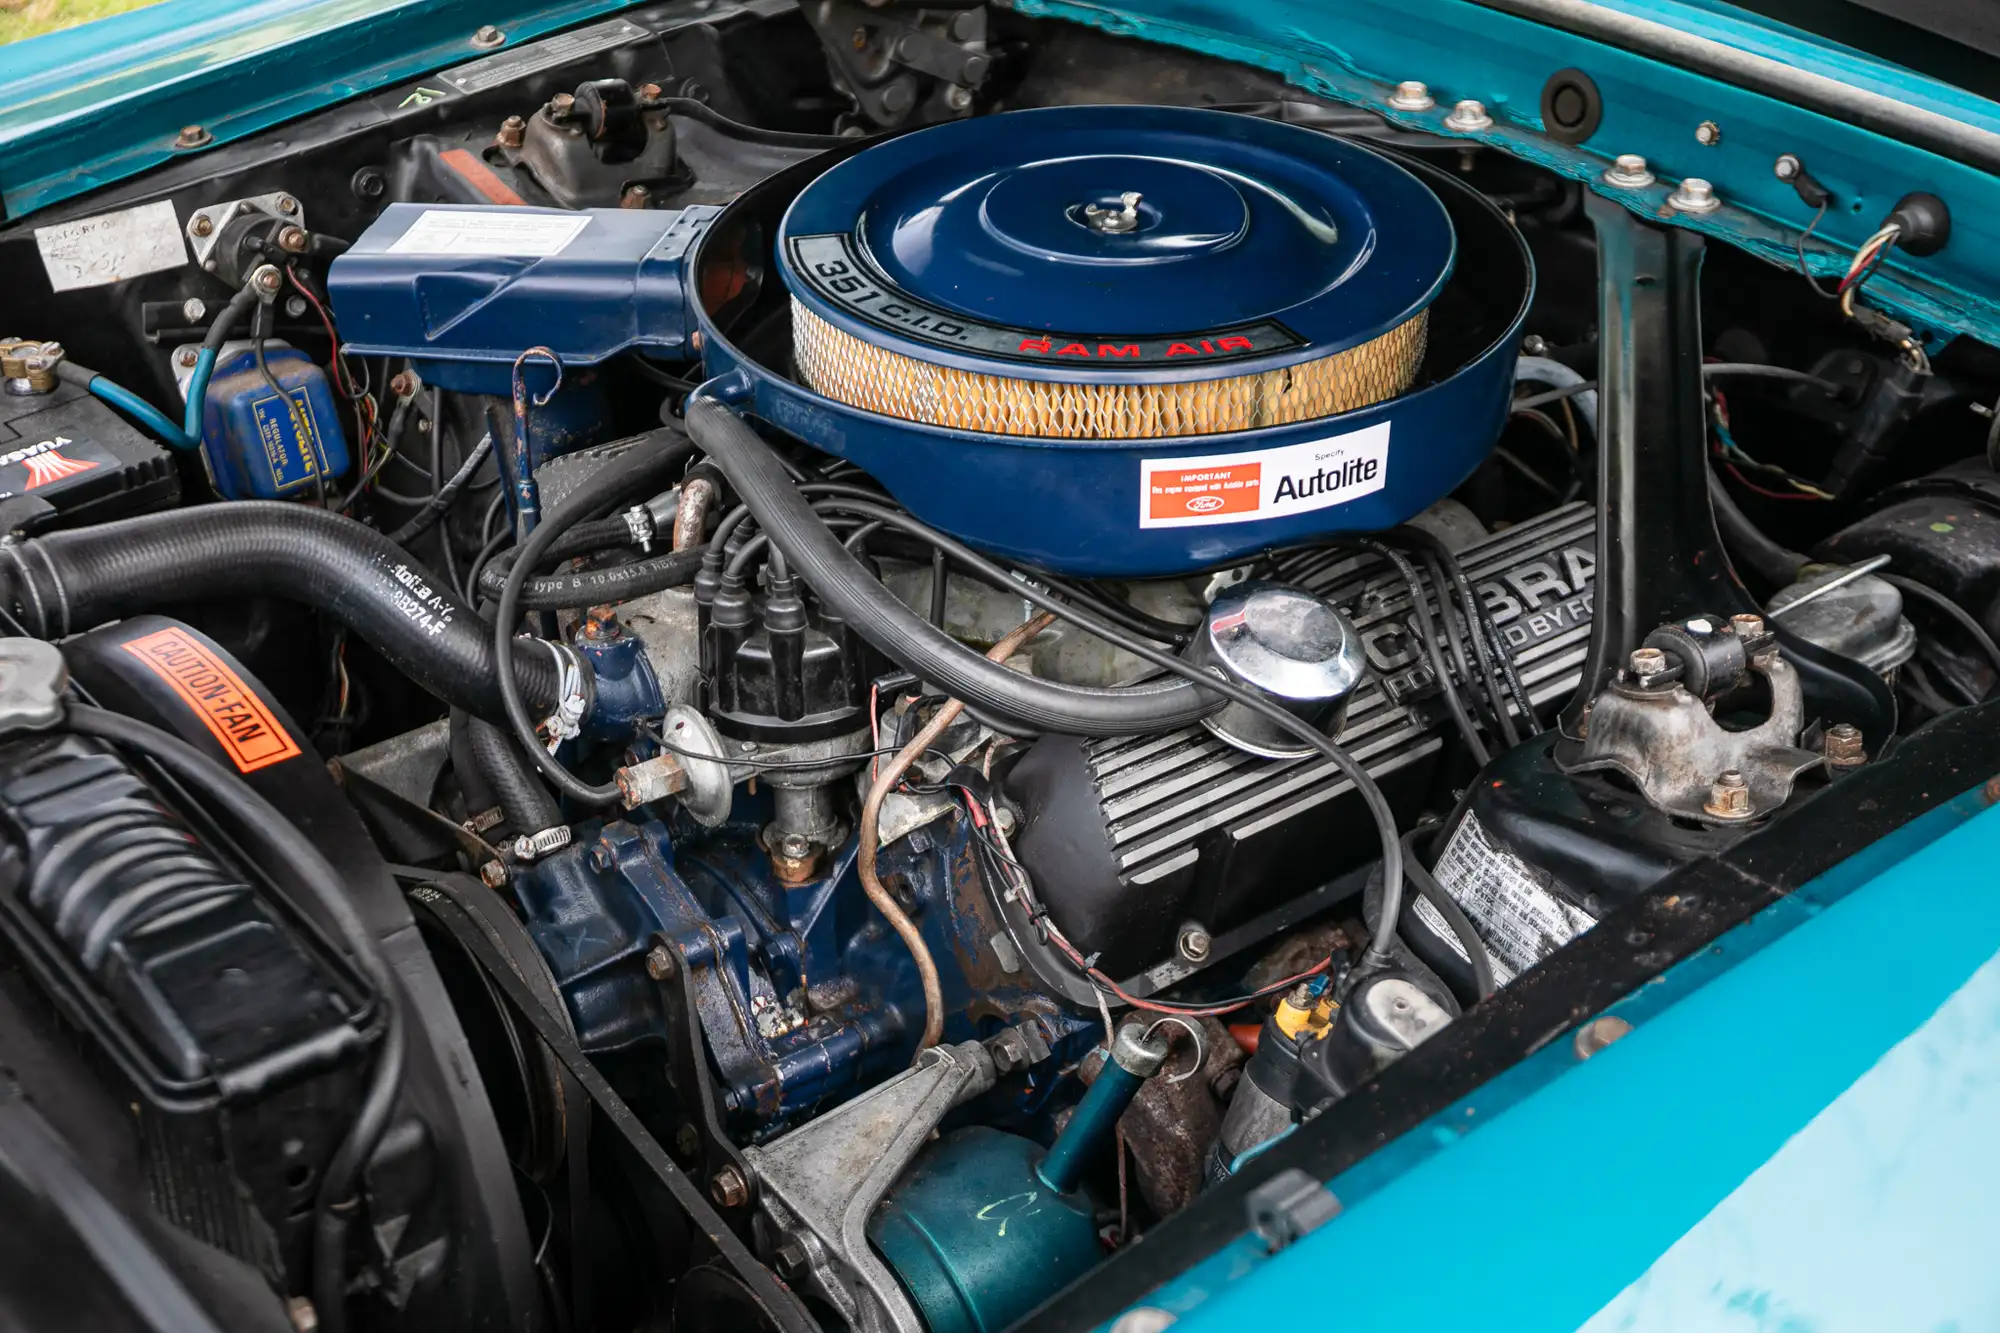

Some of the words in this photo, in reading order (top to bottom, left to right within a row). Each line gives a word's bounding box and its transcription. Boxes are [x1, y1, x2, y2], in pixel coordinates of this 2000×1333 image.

[815, 260, 882, 304] 351
[878, 303, 969, 341] C.I.D.
[1018, 338, 1141, 358] RAM
[1165, 335, 1254, 357] AIR
[269, 417, 289, 466] REGULATOR
[1314, 449, 1345, 461] Specify
[1180, 471, 1232, 483] IMPORTANT
[1273, 457, 1379, 504] Autolite
[534, 579, 564, 593] type
[572, 577, 582, 588] B
[1529, 607, 1565, 637] BY
[150, 640, 267, 743] CAUTION-FAN
